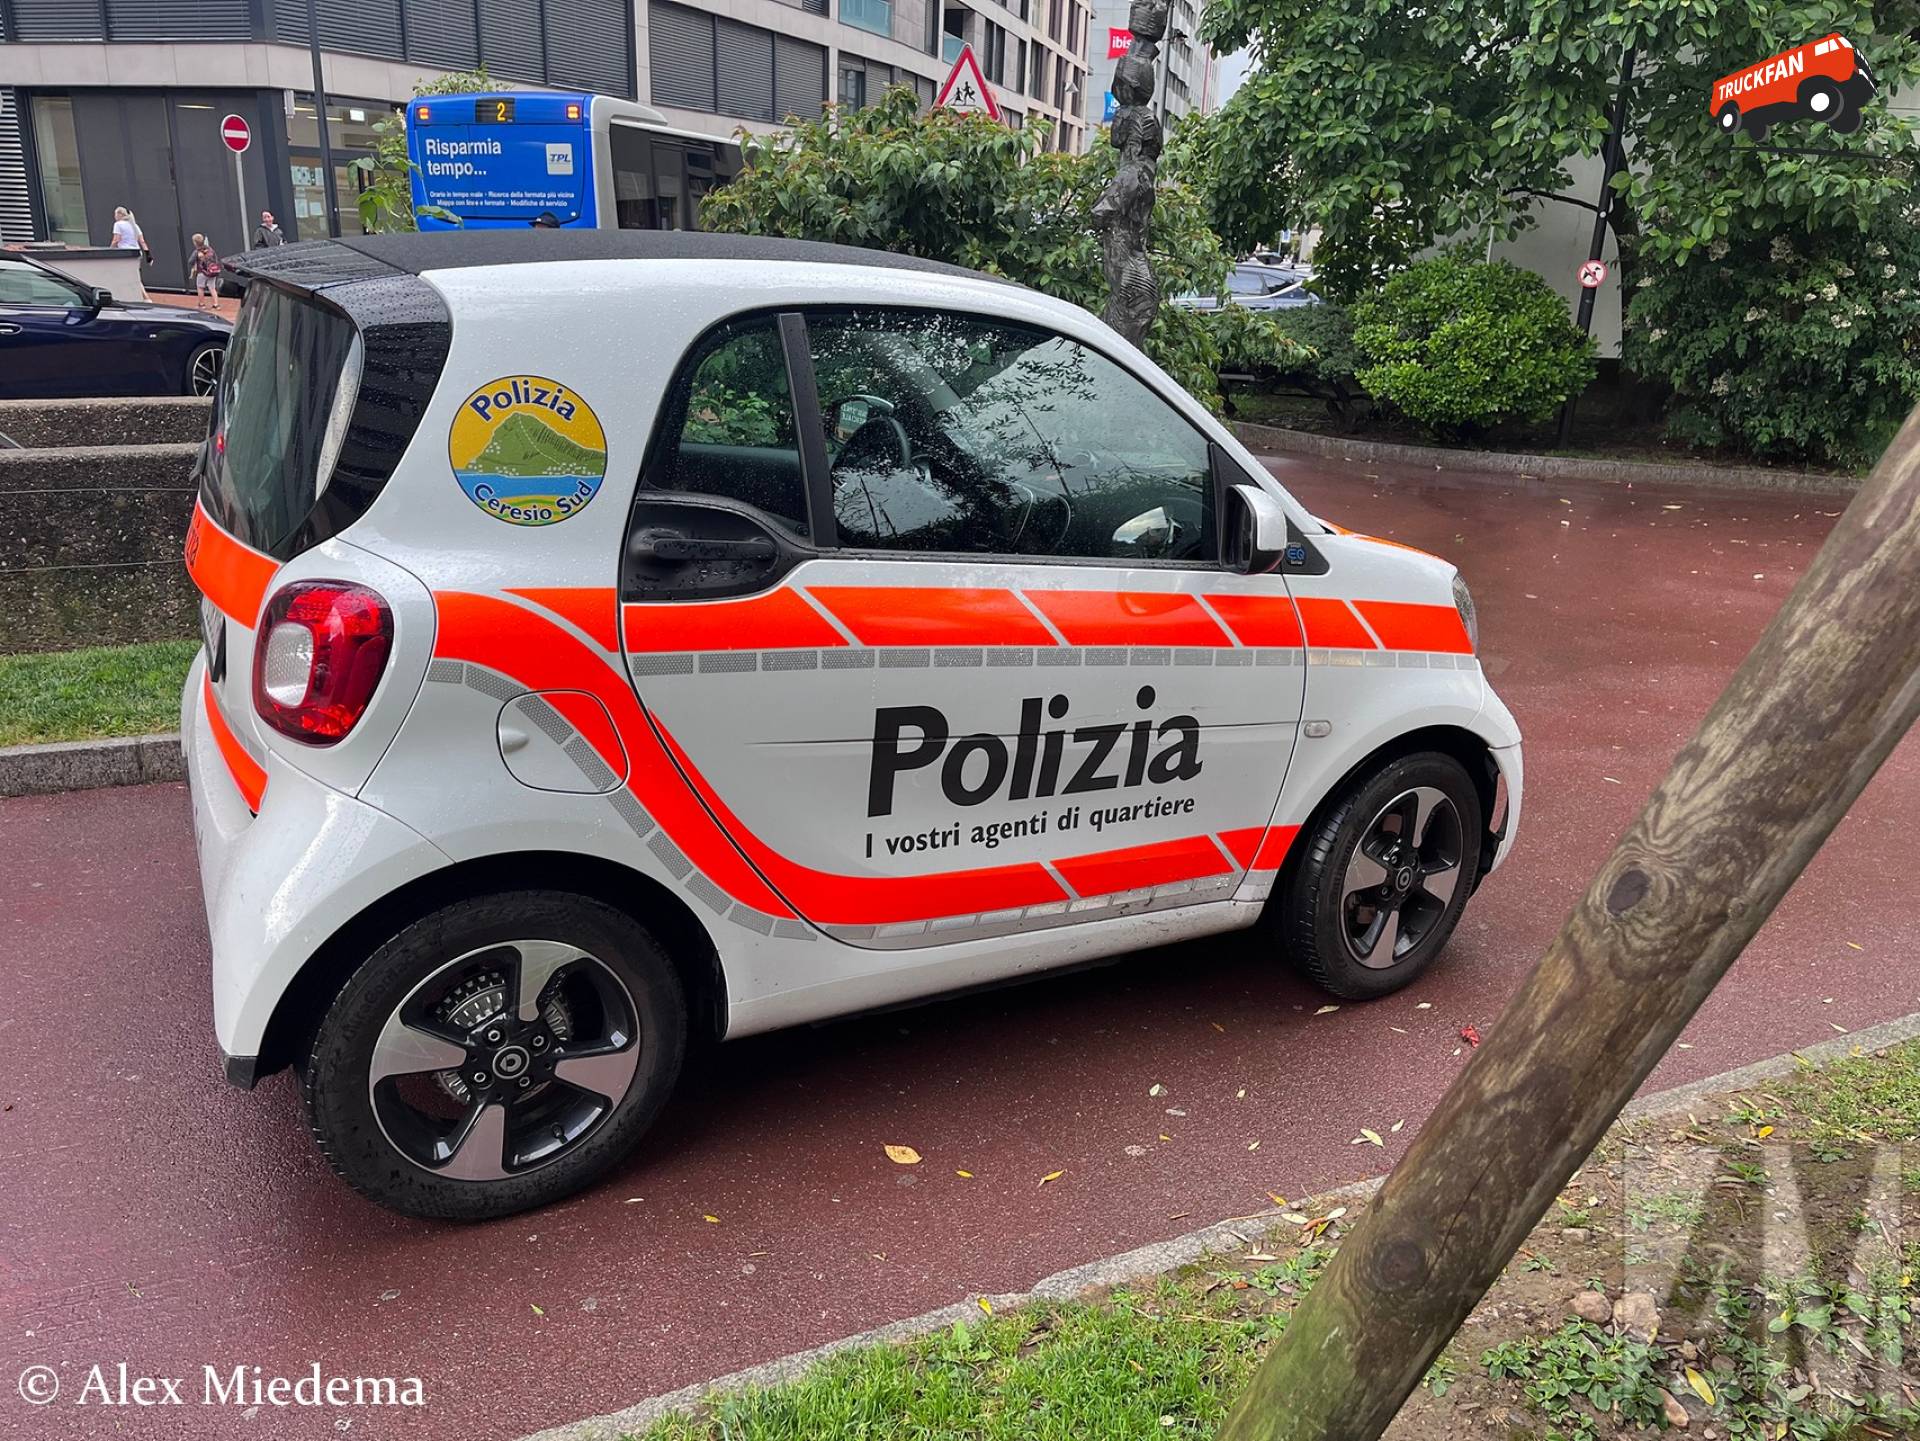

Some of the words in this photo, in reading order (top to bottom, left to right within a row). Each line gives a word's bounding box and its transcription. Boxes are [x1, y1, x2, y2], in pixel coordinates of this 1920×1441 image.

[496, 101, 506, 122] 2
[425, 138, 502, 160] Risparmia
[549, 153, 571, 163] TPL
[426, 159, 488, 180] tempo...
[545, 199, 568, 207] servizio
[469, 379, 576, 422] Polizia
[474, 483, 552, 521] Ceresio
[556, 480, 593, 514] Sud
[867, 685, 1204, 817] Polizia
[866, 833, 873, 858] I
[885, 822, 960, 855] vostri
[970, 810, 1048, 849] agenti
[1057, 806, 1080, 831] di
[1089, 796, 1196, 832] quartiere
